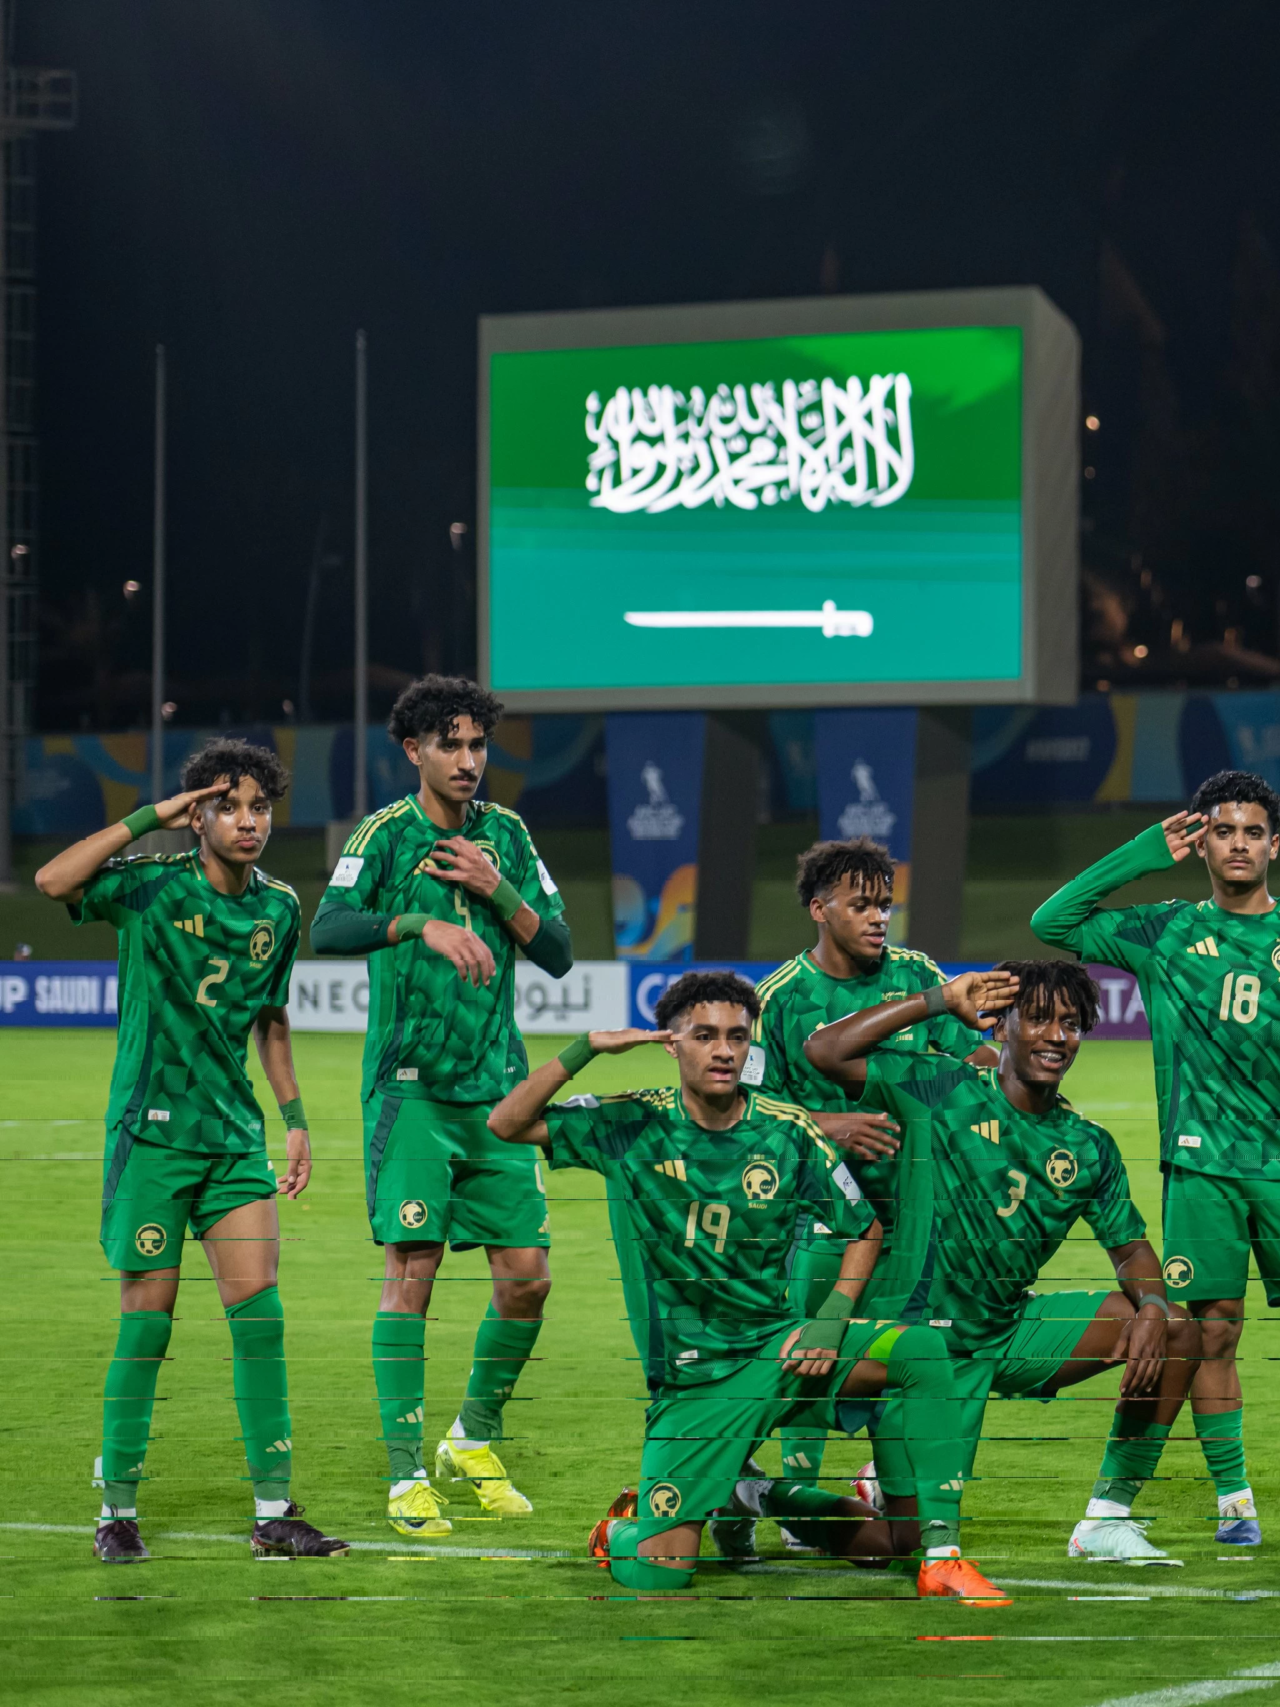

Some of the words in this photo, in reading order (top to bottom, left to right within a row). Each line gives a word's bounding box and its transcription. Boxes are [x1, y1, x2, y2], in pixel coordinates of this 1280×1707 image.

[0, 975, 28, 1013] P
[35, 975, 100, 1014] SAUDI
[195, 956, 229, 1008] 2
[297, 980, 369, 1013] NEO
[1220, 972, 1261, 1024] 18
[997, 1169, 1027, 1217] 3
[684, 1201, 730, 1253] 19
